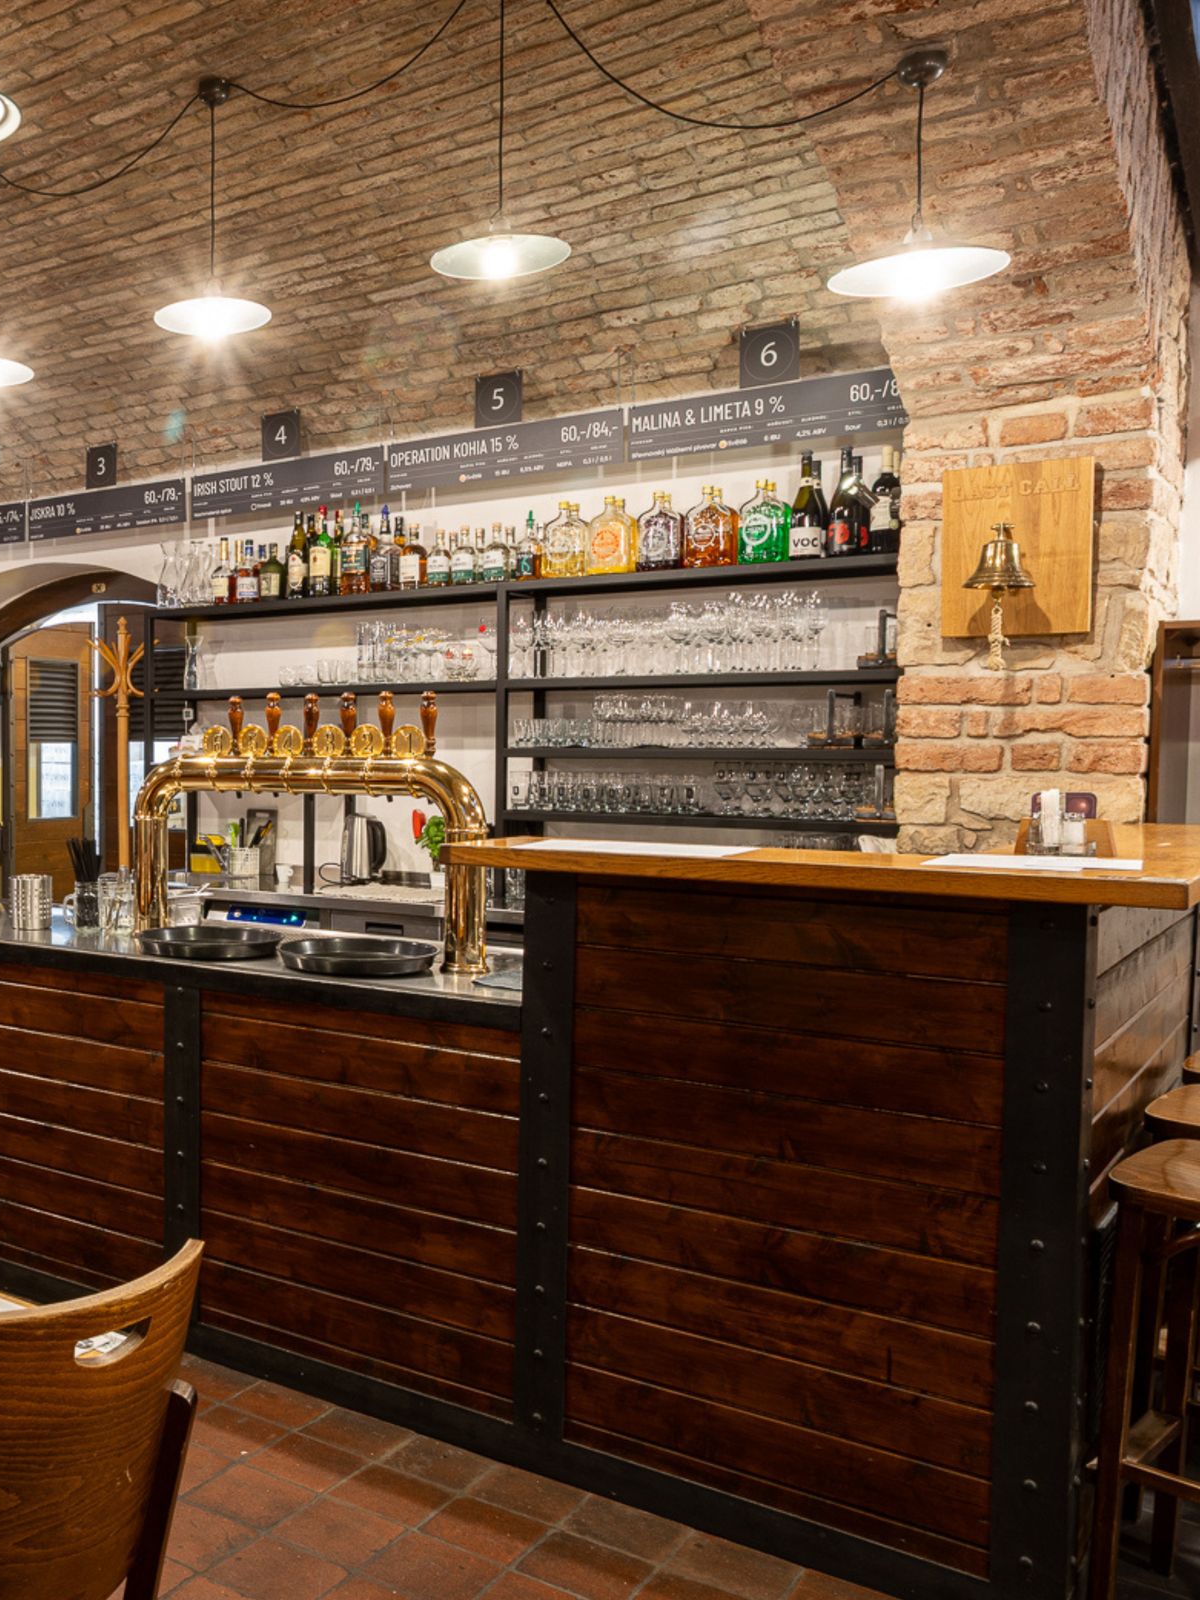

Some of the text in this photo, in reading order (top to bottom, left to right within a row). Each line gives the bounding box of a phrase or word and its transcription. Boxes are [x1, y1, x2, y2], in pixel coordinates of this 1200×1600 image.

[761, 341, 777, 366] 6
[491, 388, 504, 410] 5
[850, 379, 900, 402] 60,-/8
[632, 396, 785, 433] MALINA & LIMETA 9 %
[274, 425, 288, 445] 4
[561, 421, 618, 443] 60,-/84,-
[390, 434, 519, 468] OPERATION KOHIA 15 %
[96, 457, 106, 475] 3
[334, 457, 380, 475] 60,-/79,-
[144, 487, 182, 504] 60,-/79,-
[193, 472, 274, 497] IRISH STOUT 12 %
[952, 472, 1080, 502] LAST CALL
[30, 505, 55, 521] JISKRA
[56, 503, 65, 517] 10
[66, 502, 76, 515] %
